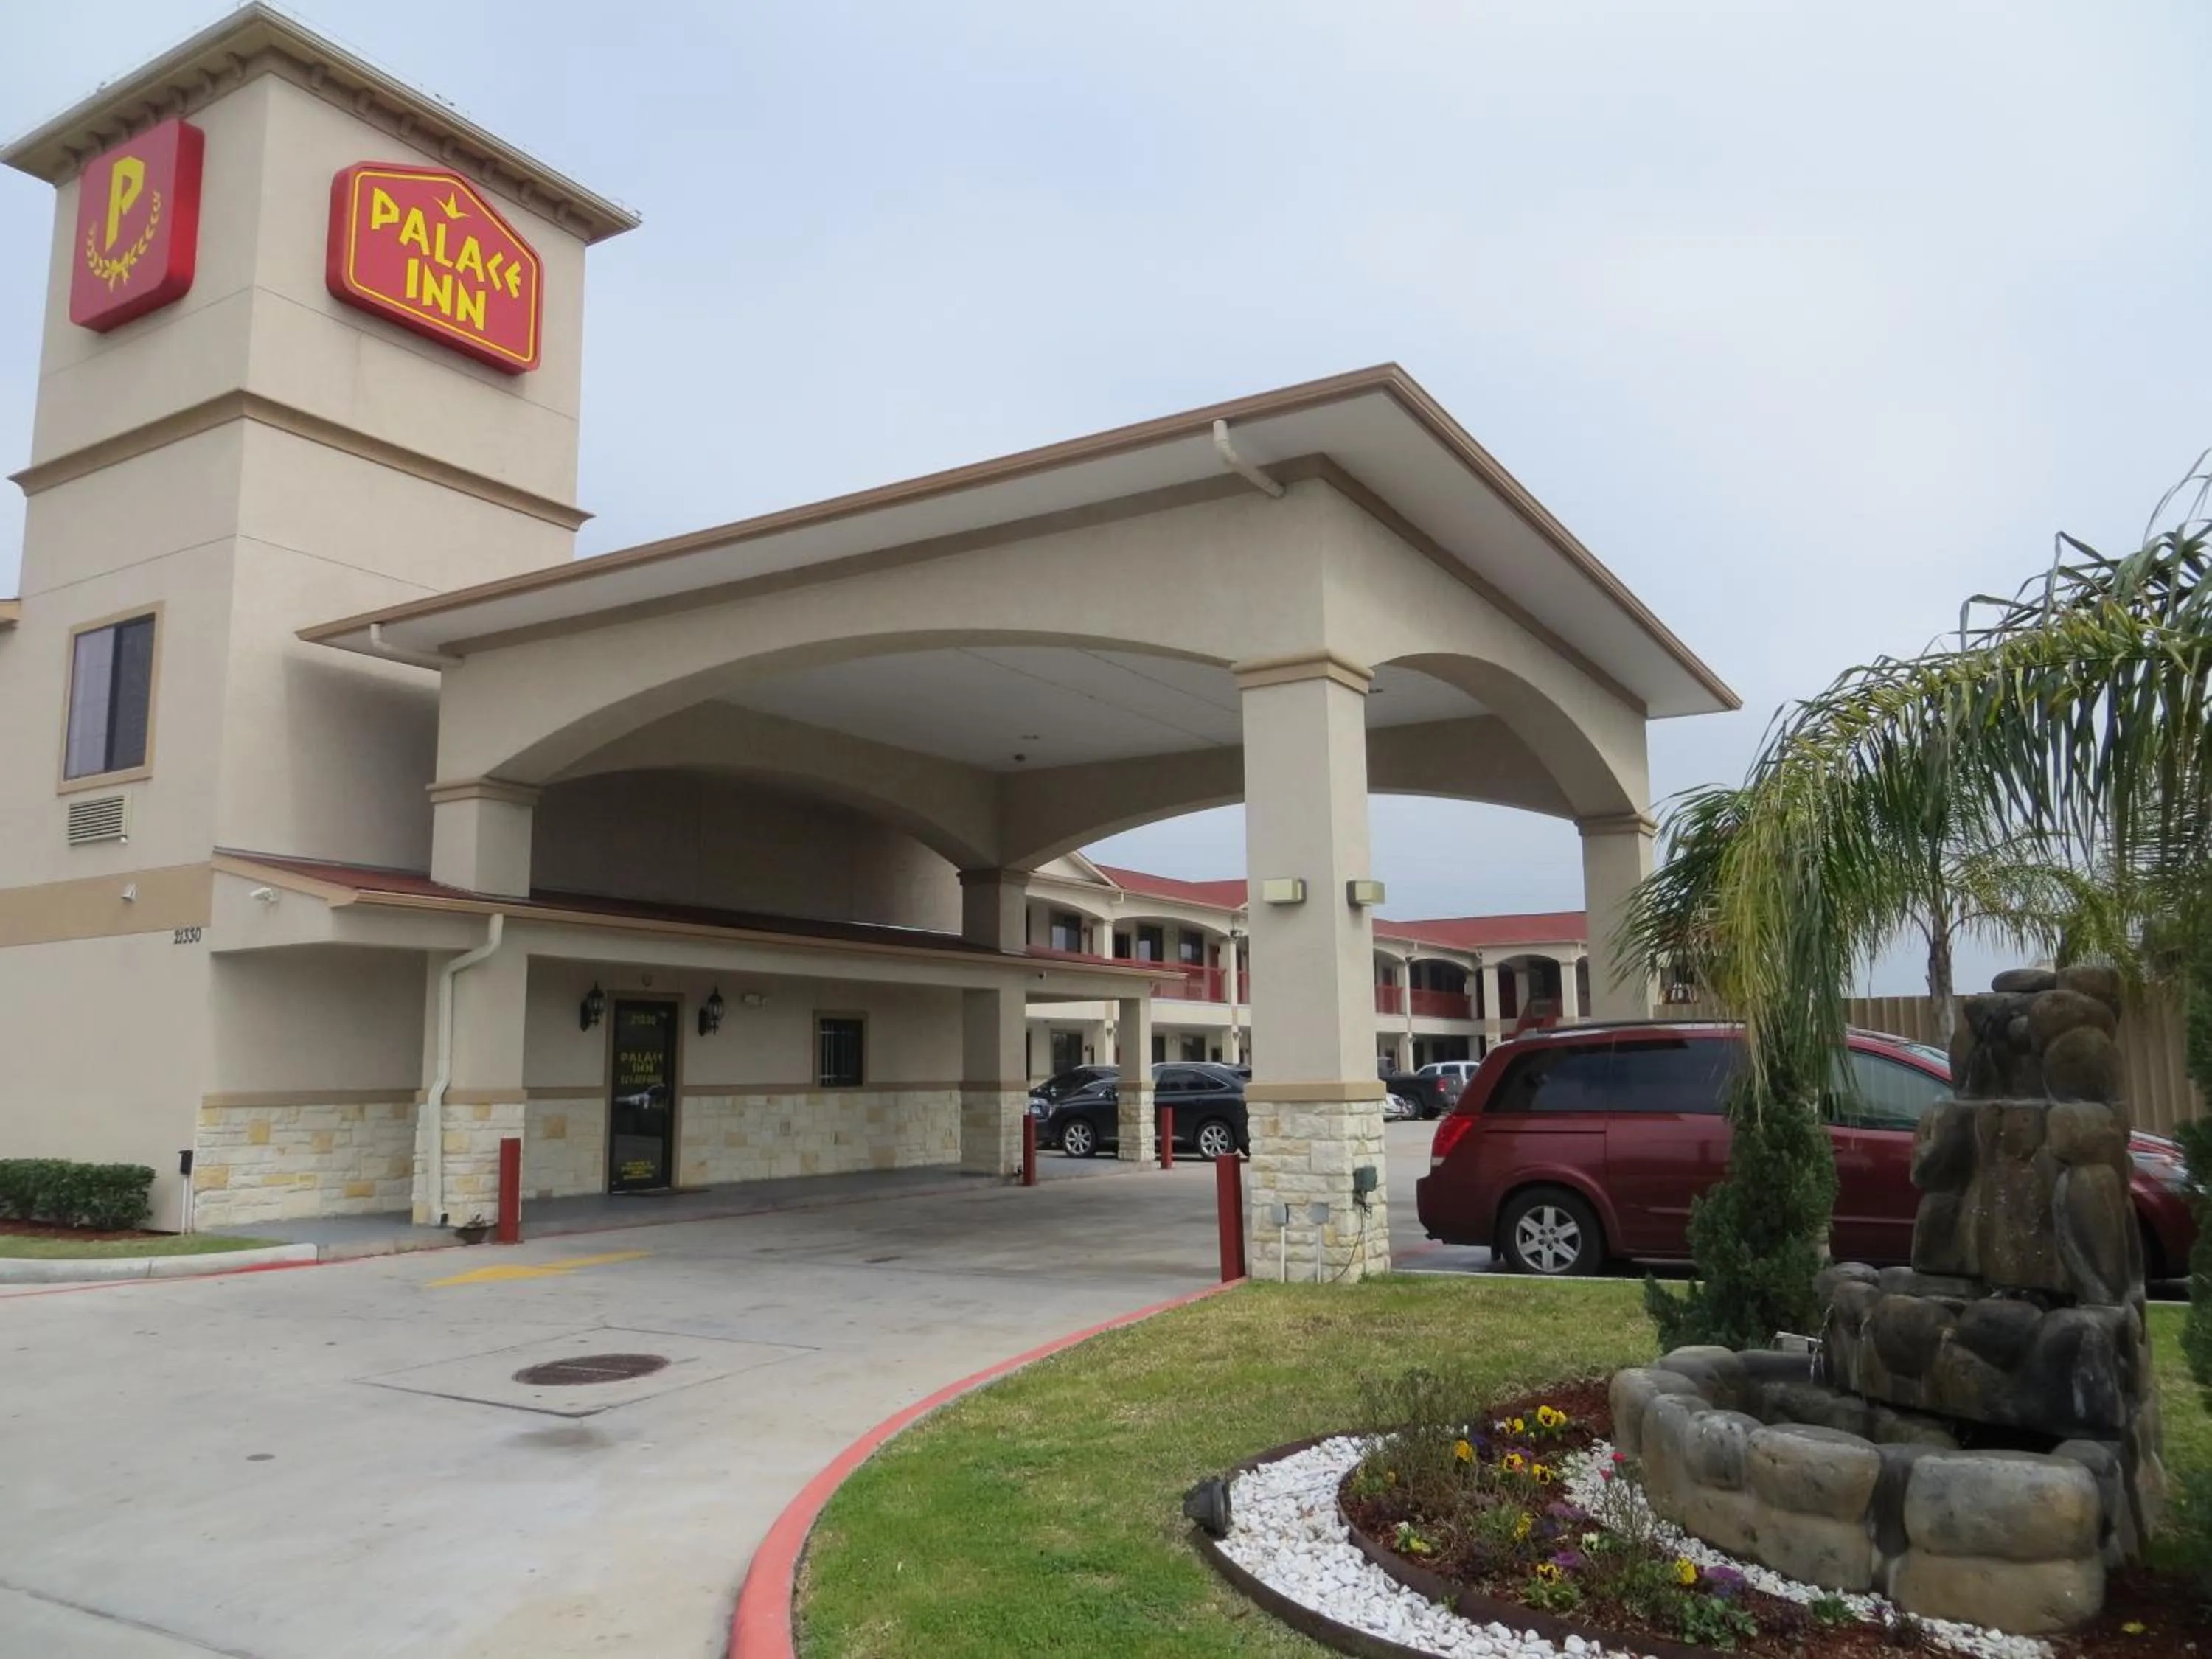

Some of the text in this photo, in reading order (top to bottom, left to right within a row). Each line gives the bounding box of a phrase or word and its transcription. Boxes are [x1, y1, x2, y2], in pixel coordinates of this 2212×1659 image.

[105, 155, 145, 252] P
[371, 187, 521, 298] PALACE
[406, 258, 487, 330] INN
